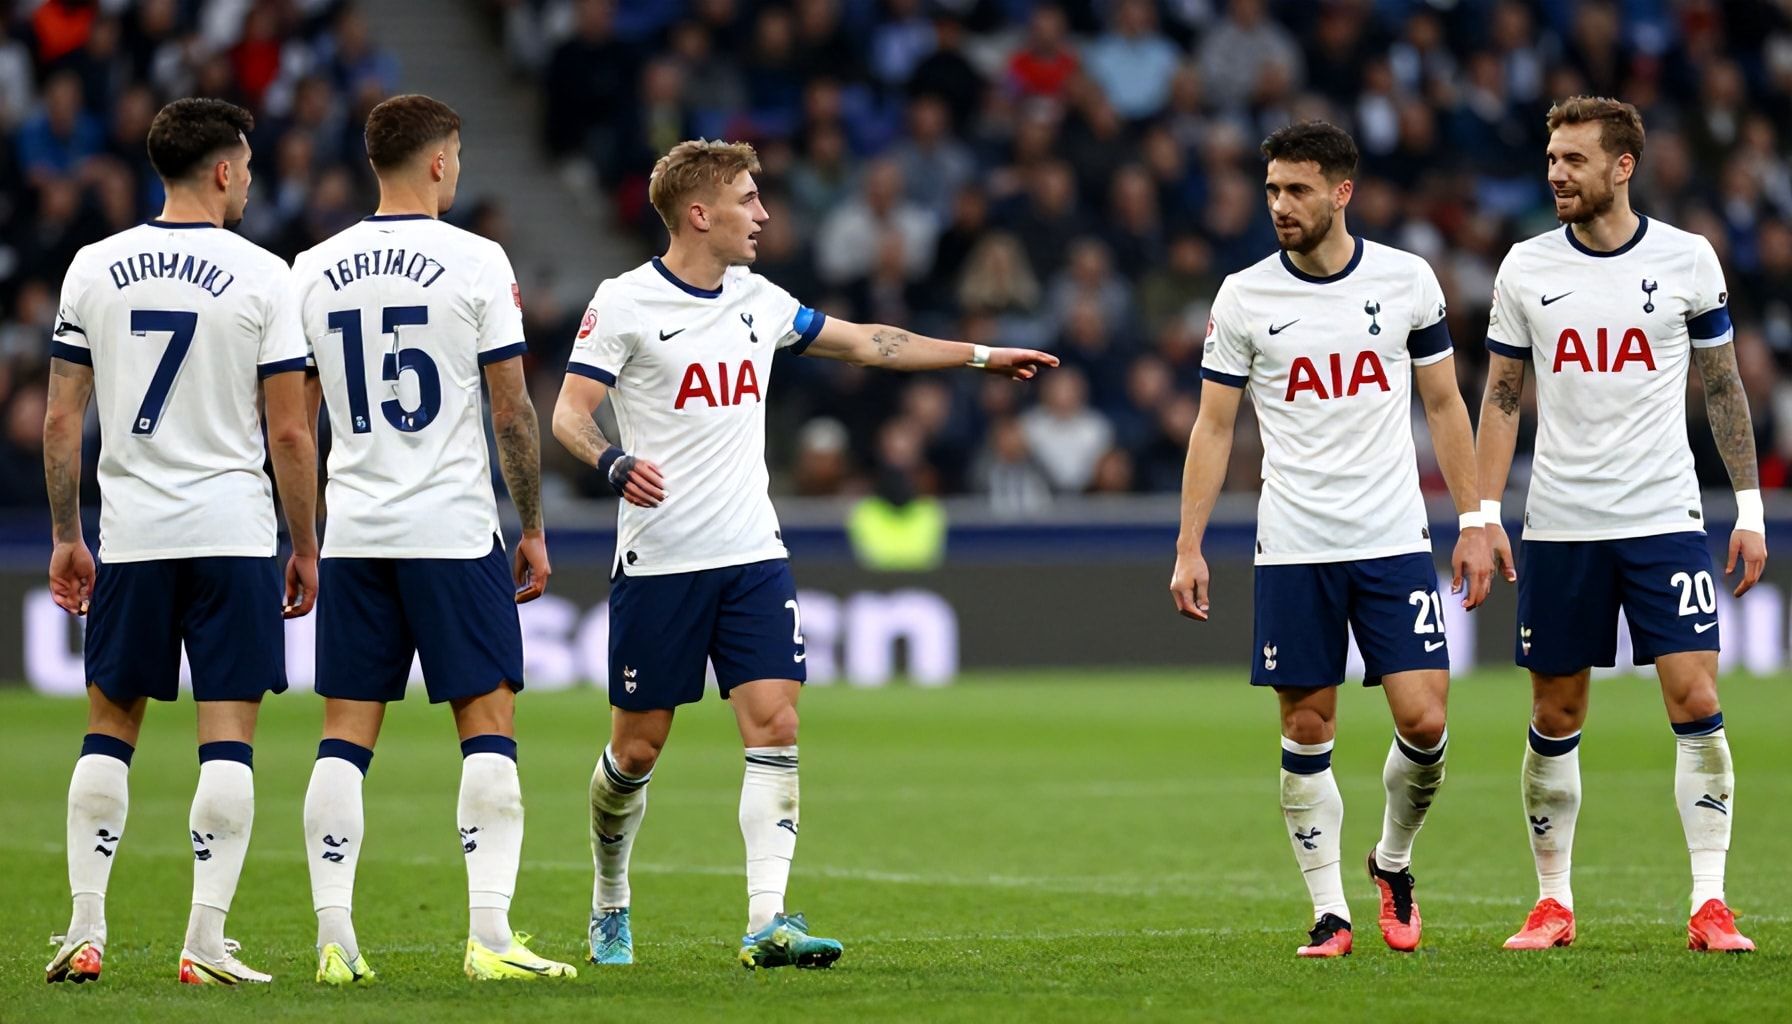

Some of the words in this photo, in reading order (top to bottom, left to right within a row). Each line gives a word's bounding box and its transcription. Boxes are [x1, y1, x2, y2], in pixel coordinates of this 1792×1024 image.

[131, 310, 198, 435] 7
[328, 305, 441, 433] 15
[1285, 350, 1390, 401] AIA
[1552, 327, 1656, 373] AIA
[674, 359, 761, 410] AIA
[1670, 570, 1716, 616] 20
